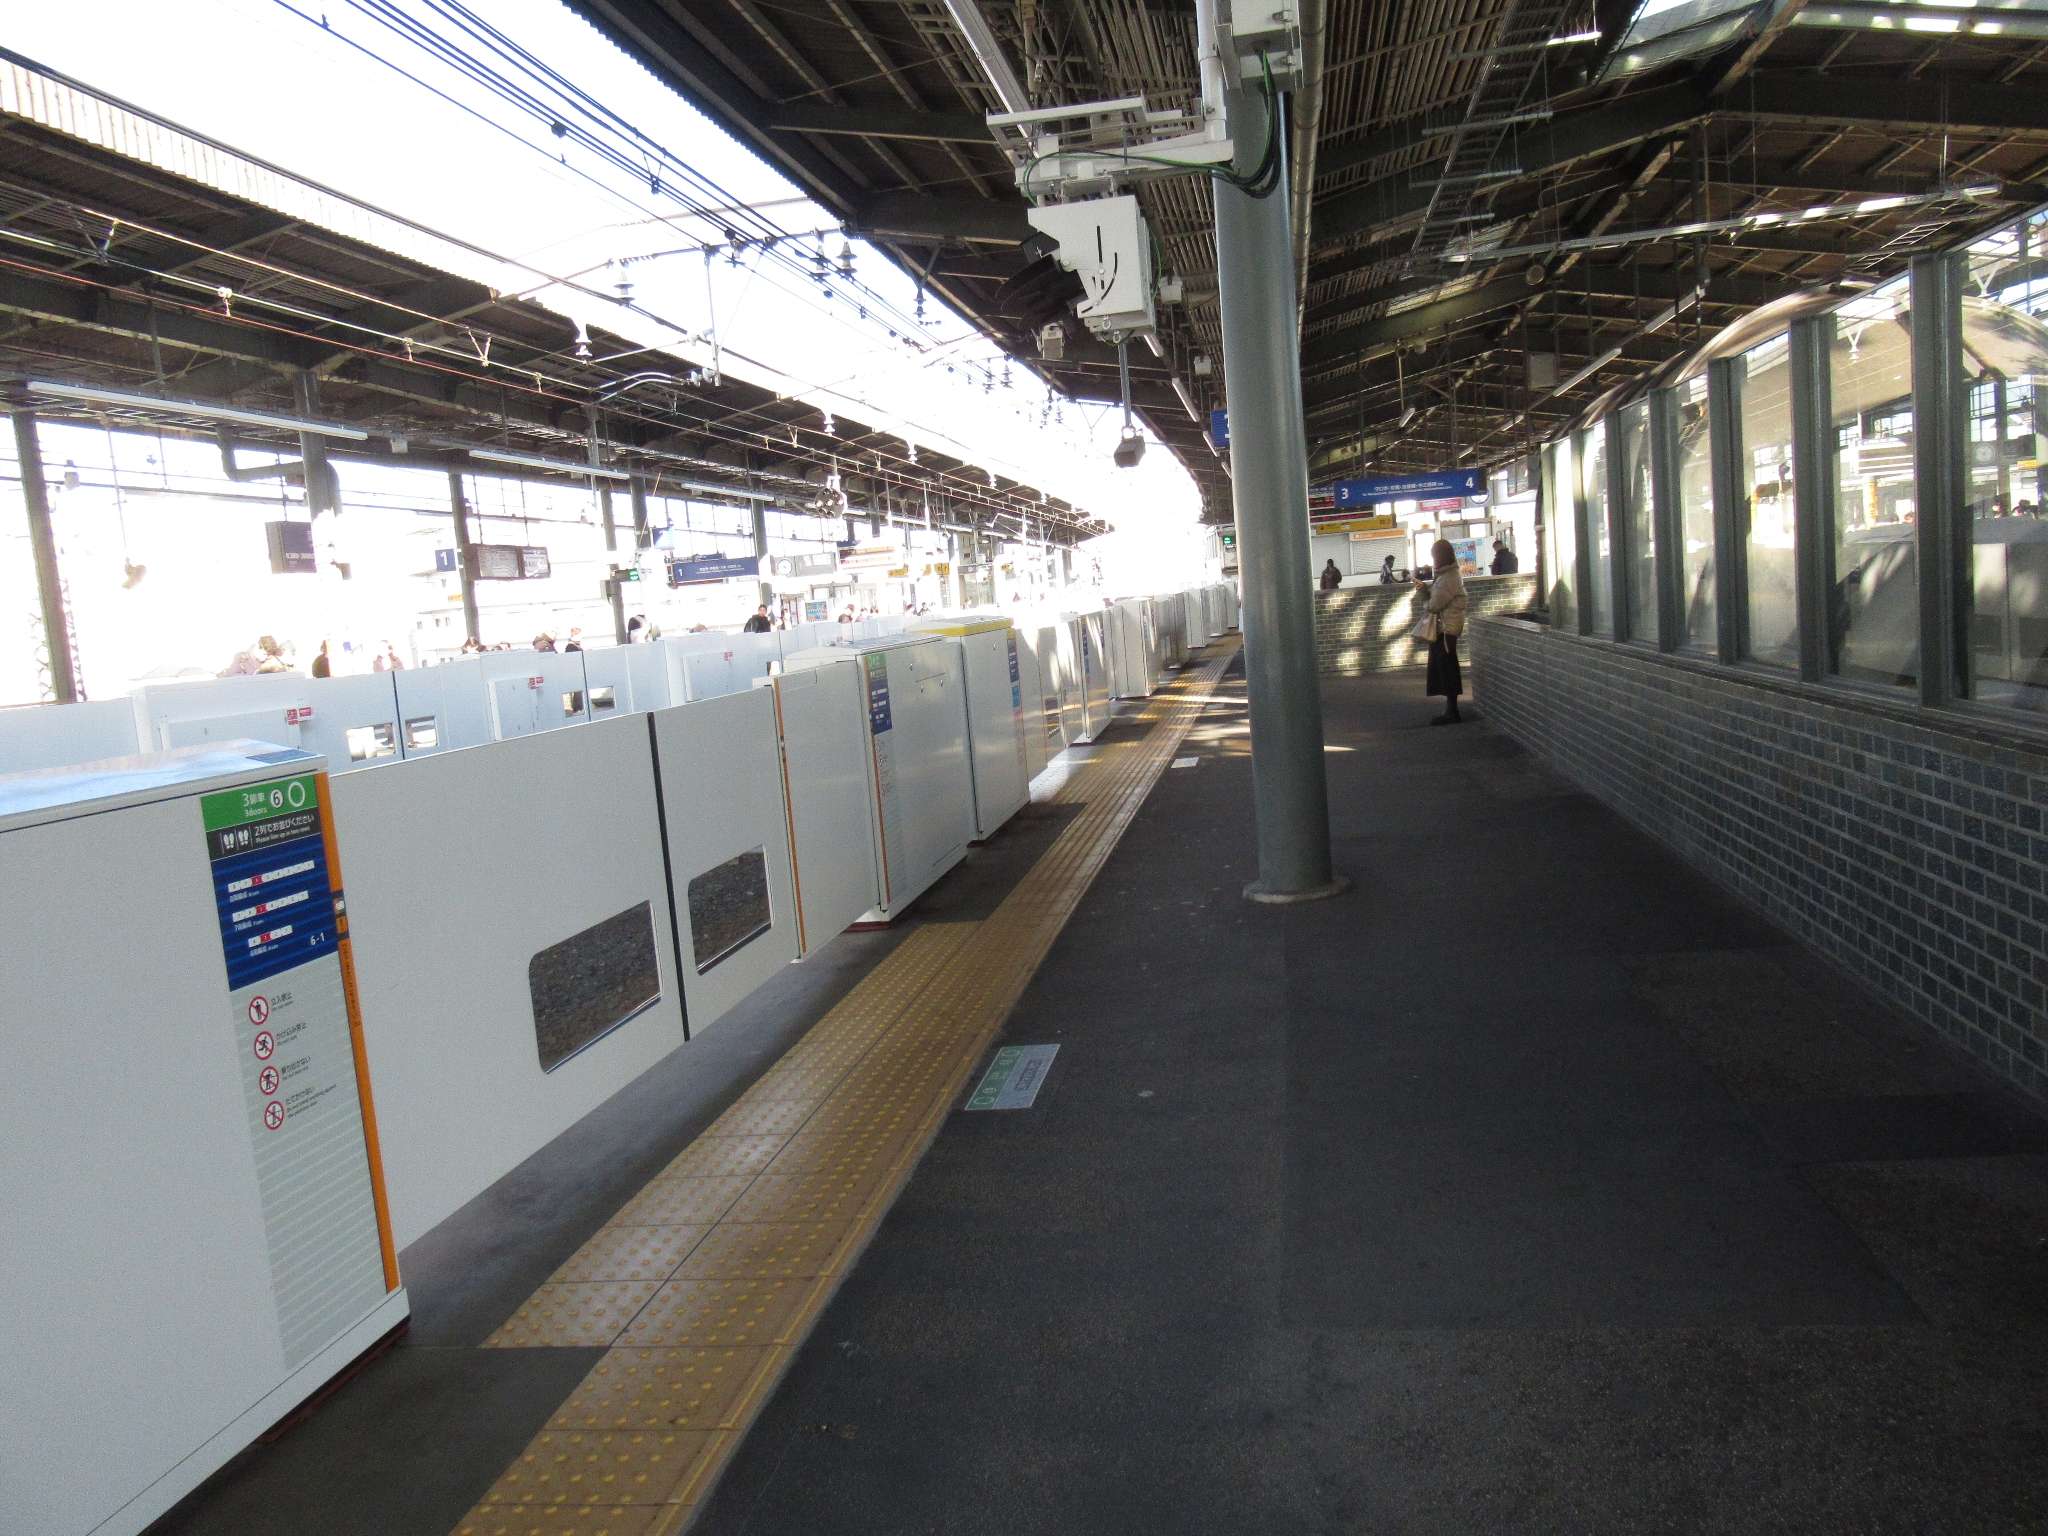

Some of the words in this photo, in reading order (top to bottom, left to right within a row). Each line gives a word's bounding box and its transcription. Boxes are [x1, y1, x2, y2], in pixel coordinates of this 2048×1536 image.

[1465, 477, 1473, 488] 4
[1341, 487, 1349, 499] 3
[440, 551, 448, 566] 1
[310, 932, 325, 946] 6-1
